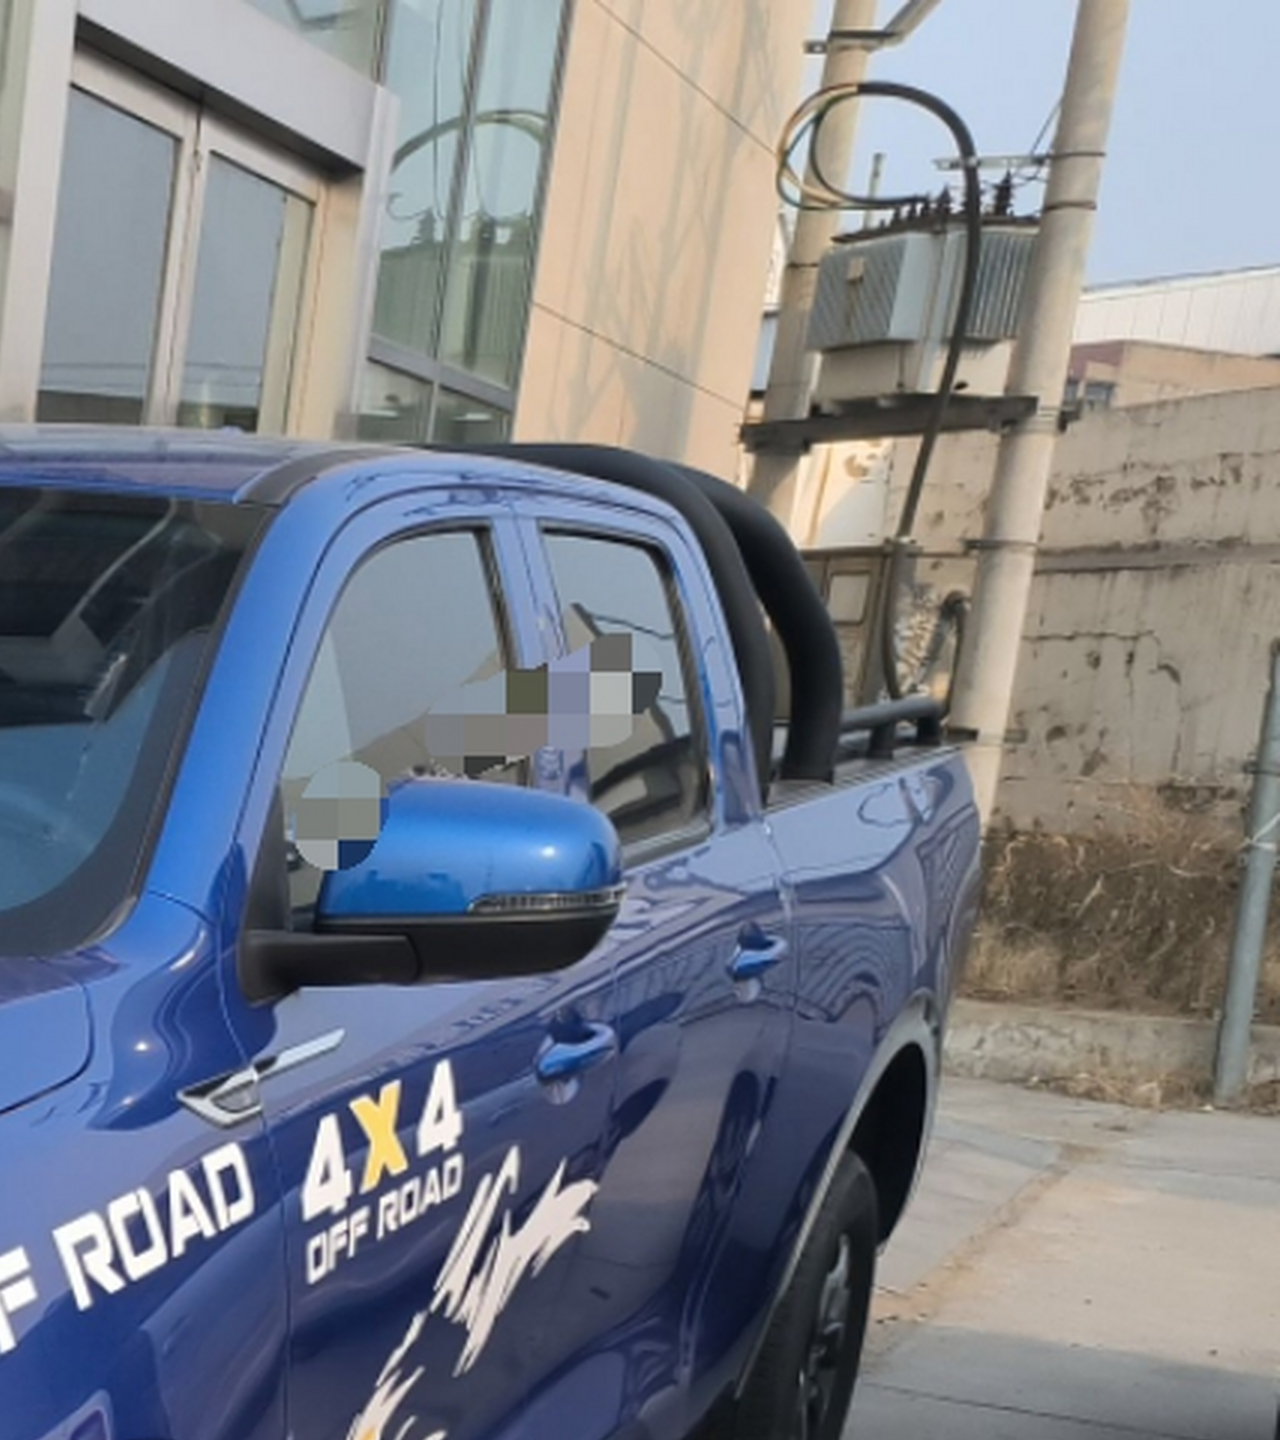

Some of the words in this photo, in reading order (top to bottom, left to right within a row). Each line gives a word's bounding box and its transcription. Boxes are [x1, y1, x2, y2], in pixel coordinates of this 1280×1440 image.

[301, 1059, 463, 1221] 4X4
[306, 1207, 370, 1285] OFF
[376, 1154, 464, 1240] ROAD
[52, 1142, 255, 1310] ROAD
